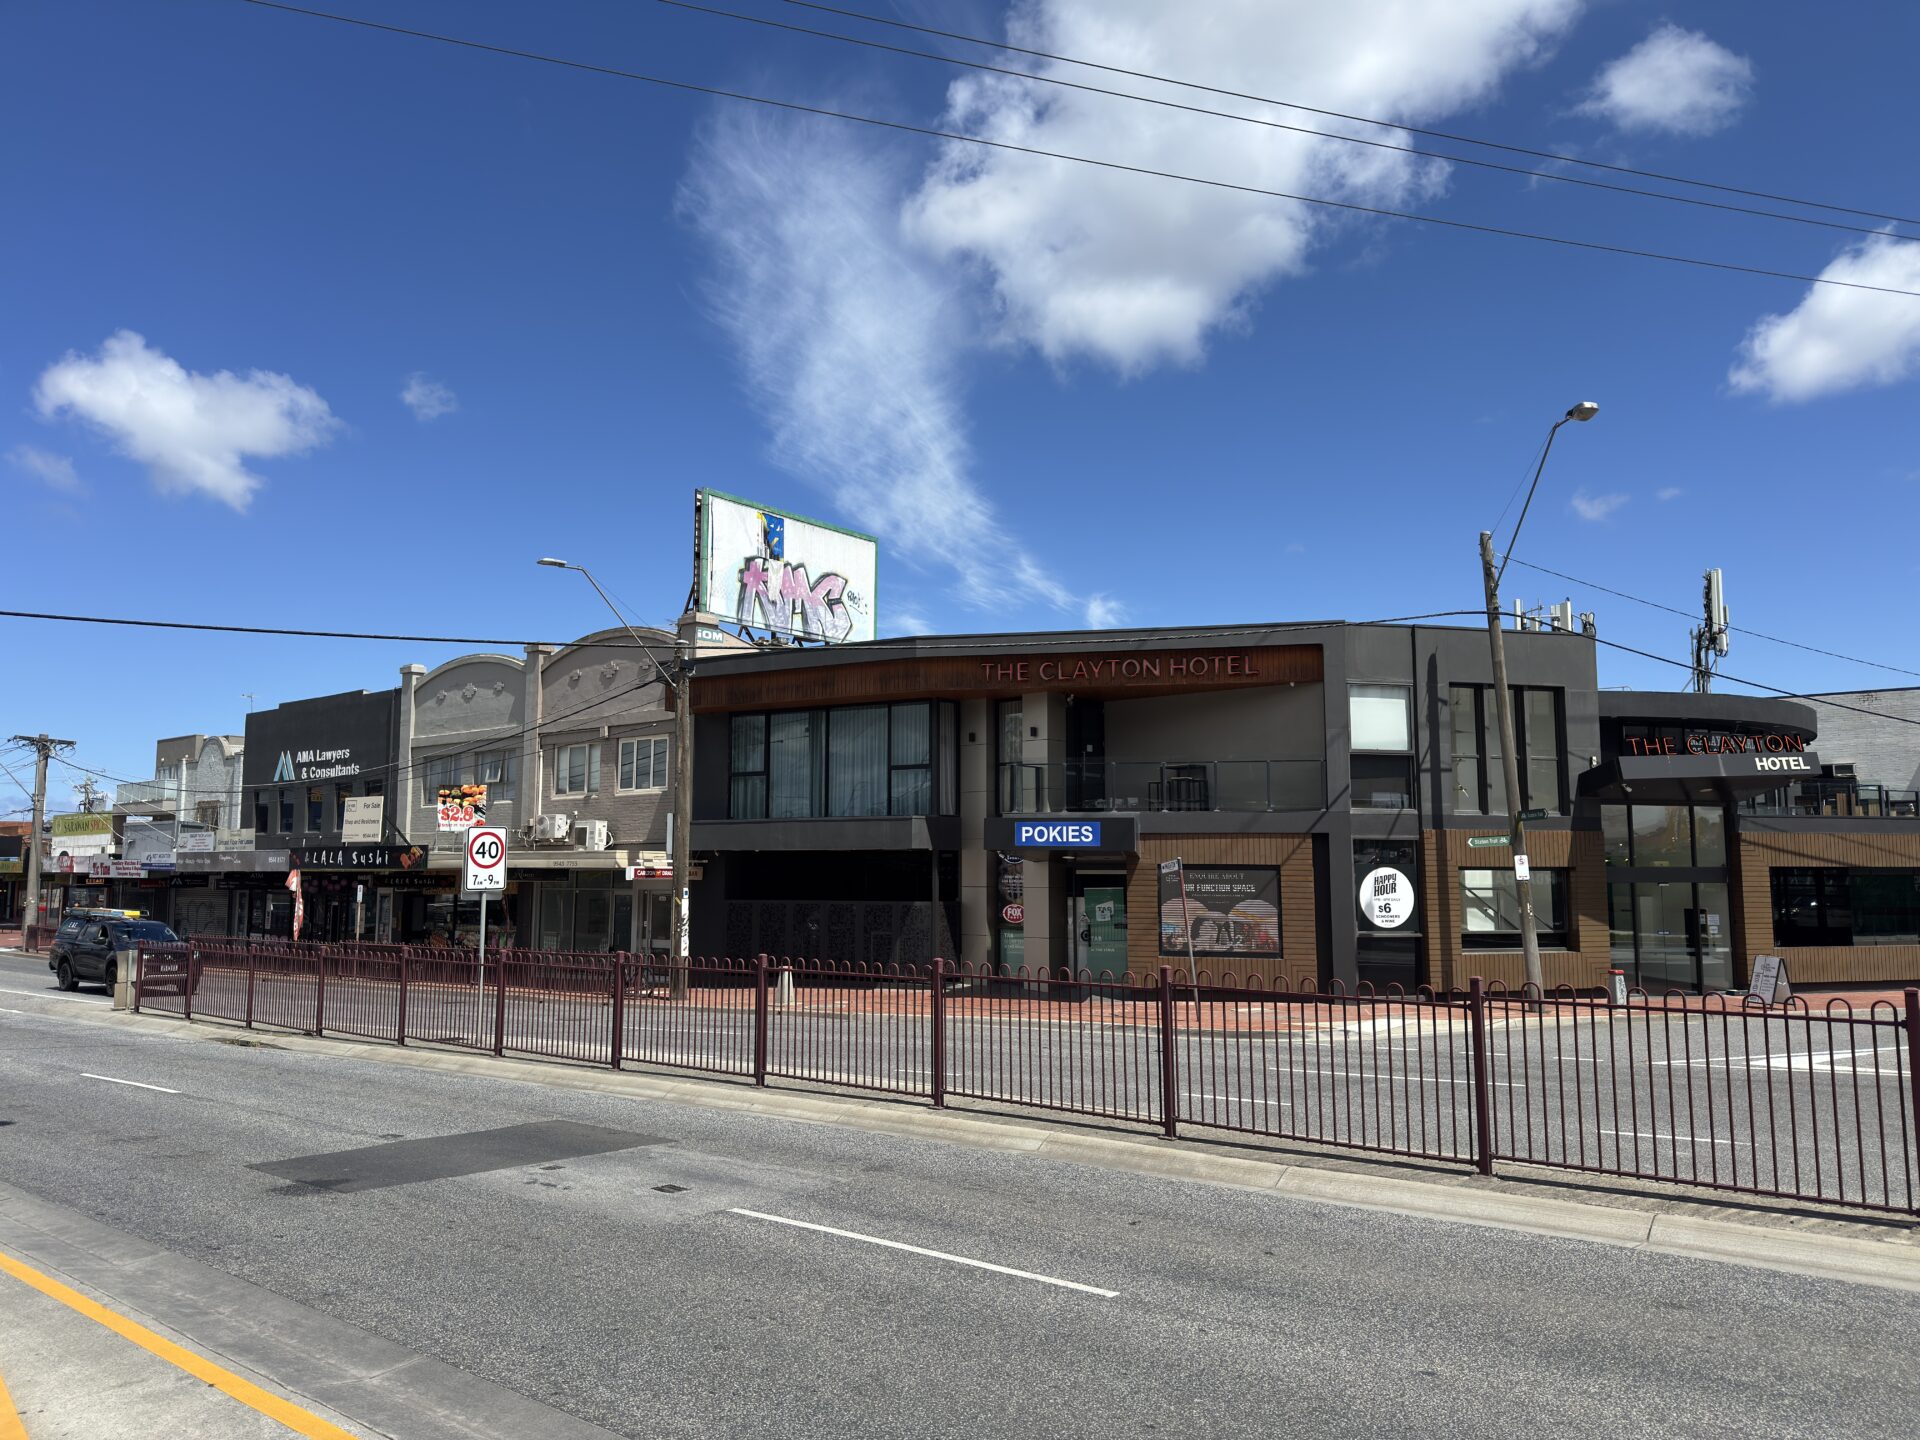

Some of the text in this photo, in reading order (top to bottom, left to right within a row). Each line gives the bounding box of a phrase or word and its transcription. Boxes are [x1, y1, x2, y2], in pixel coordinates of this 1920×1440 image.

[982, 655, 1259, 681] THE CLAYTON HOTEL
[1626, 734, 1805, 756] THE CLAYTON
[296, 748, 350, 763] AMA Lawyers
[301, 762, 360, 779] & Consultants
[1755, 756, 1810, 771] HOTEL
[1021, 825, 1093, 842] POKIES
[475, 841, 499, 859] 40
[1374, 873, 1397, 885] HAPPY
[1196, 884, 1231, 892] FUNCTION
[1232, 884, 1256, 892] SPACE
[1374, 882, 1397, 897] HOUR
[1007, 907, 1022, 916] FOX
[1378, 902, 1392, 913] $6
